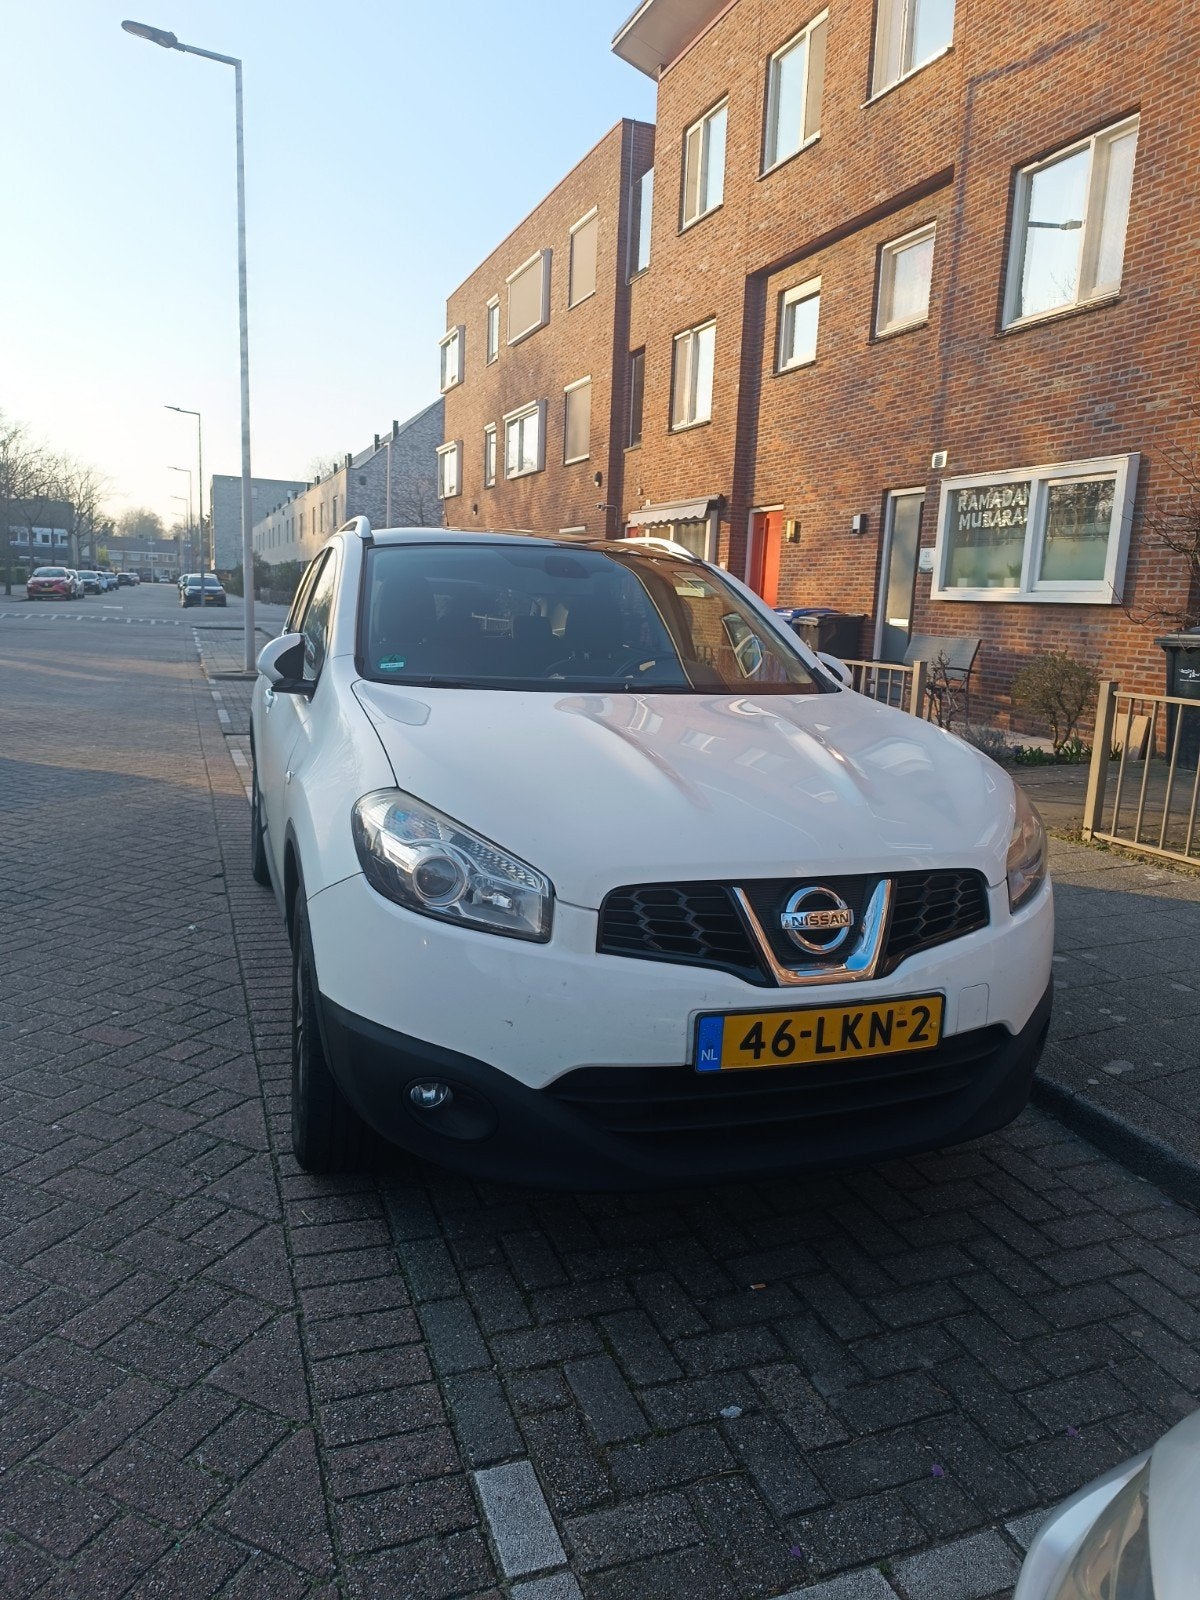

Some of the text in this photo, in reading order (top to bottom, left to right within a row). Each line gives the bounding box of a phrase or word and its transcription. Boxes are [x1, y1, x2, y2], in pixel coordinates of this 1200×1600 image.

[791, 913, 849, 926] NISSAN
[739, 1005, 931, 1060] 46-LKN-2
[701, 1048, 718, 1061] NL
